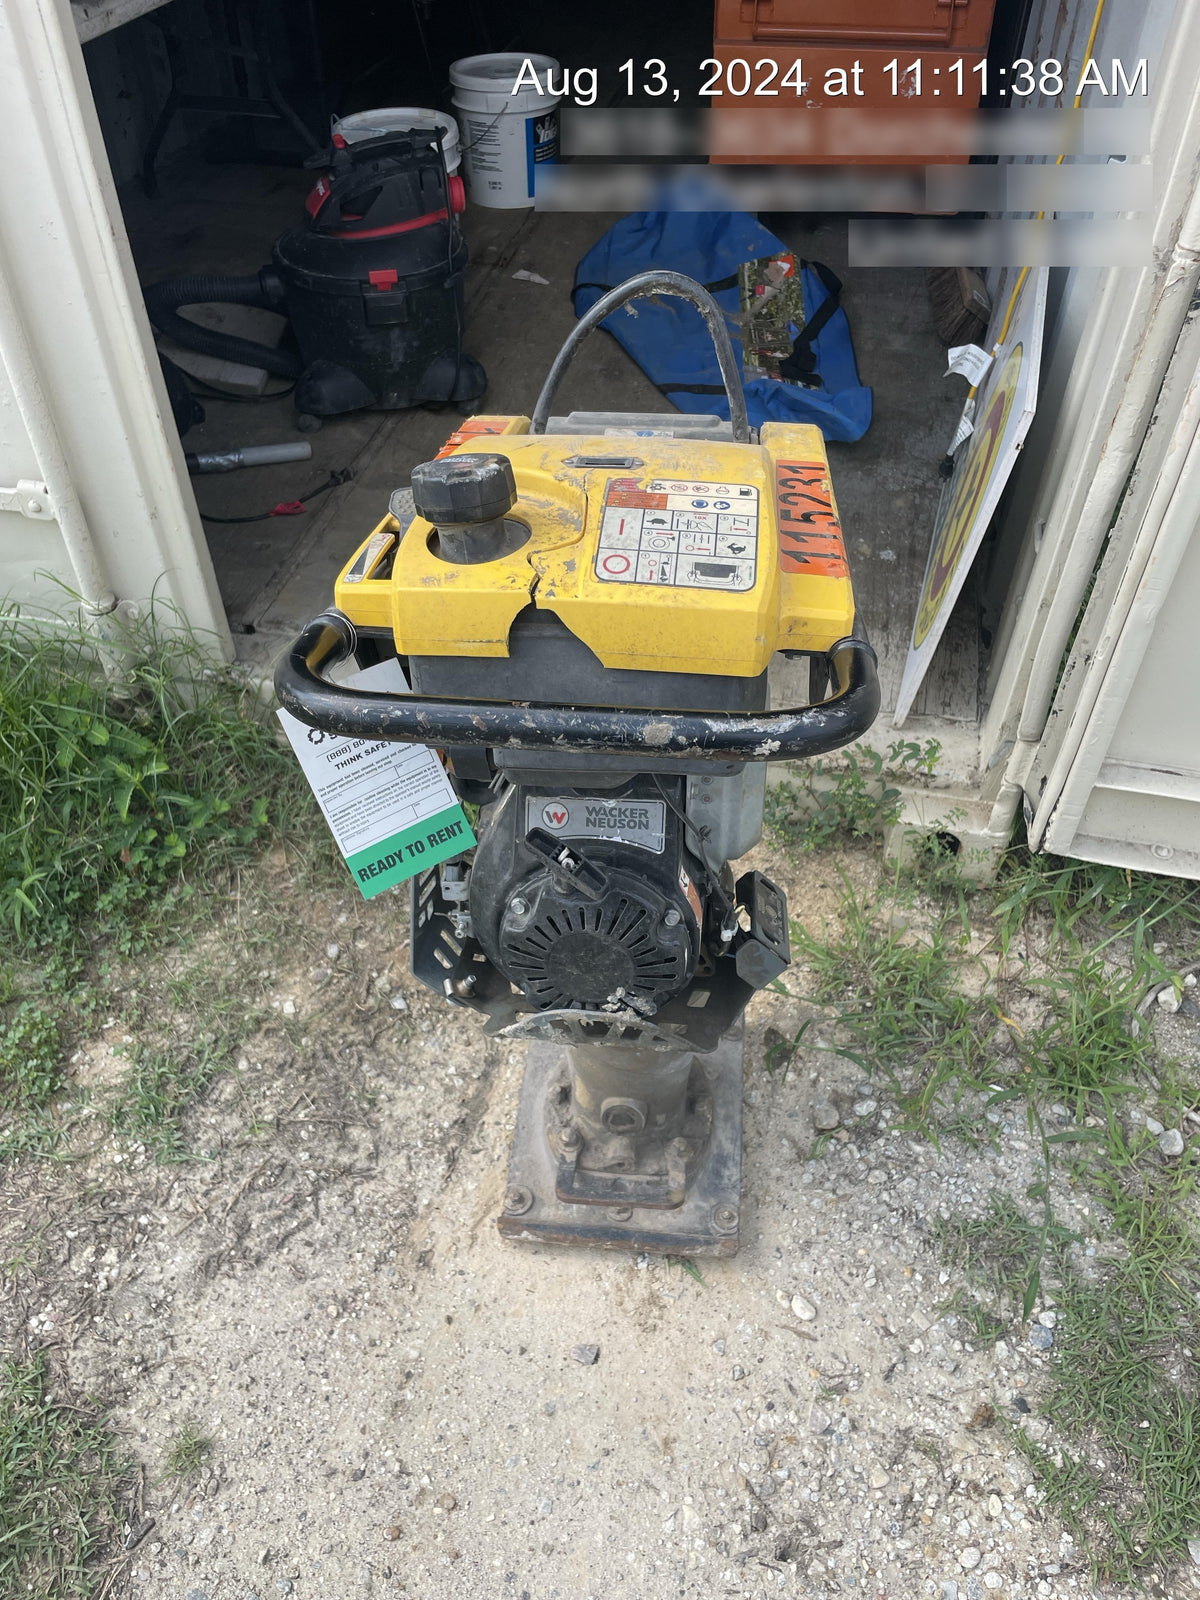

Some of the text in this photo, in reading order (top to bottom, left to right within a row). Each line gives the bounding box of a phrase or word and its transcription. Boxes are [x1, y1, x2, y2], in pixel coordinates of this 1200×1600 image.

[778, 464, 842, 565] 115231
[335, 753, 363, 770] THINK
[585, 805, 649, 819] WACKER
[585, 818, 650, 830] NEUSON
[357, 821, 464, 882] READY TO RENT
